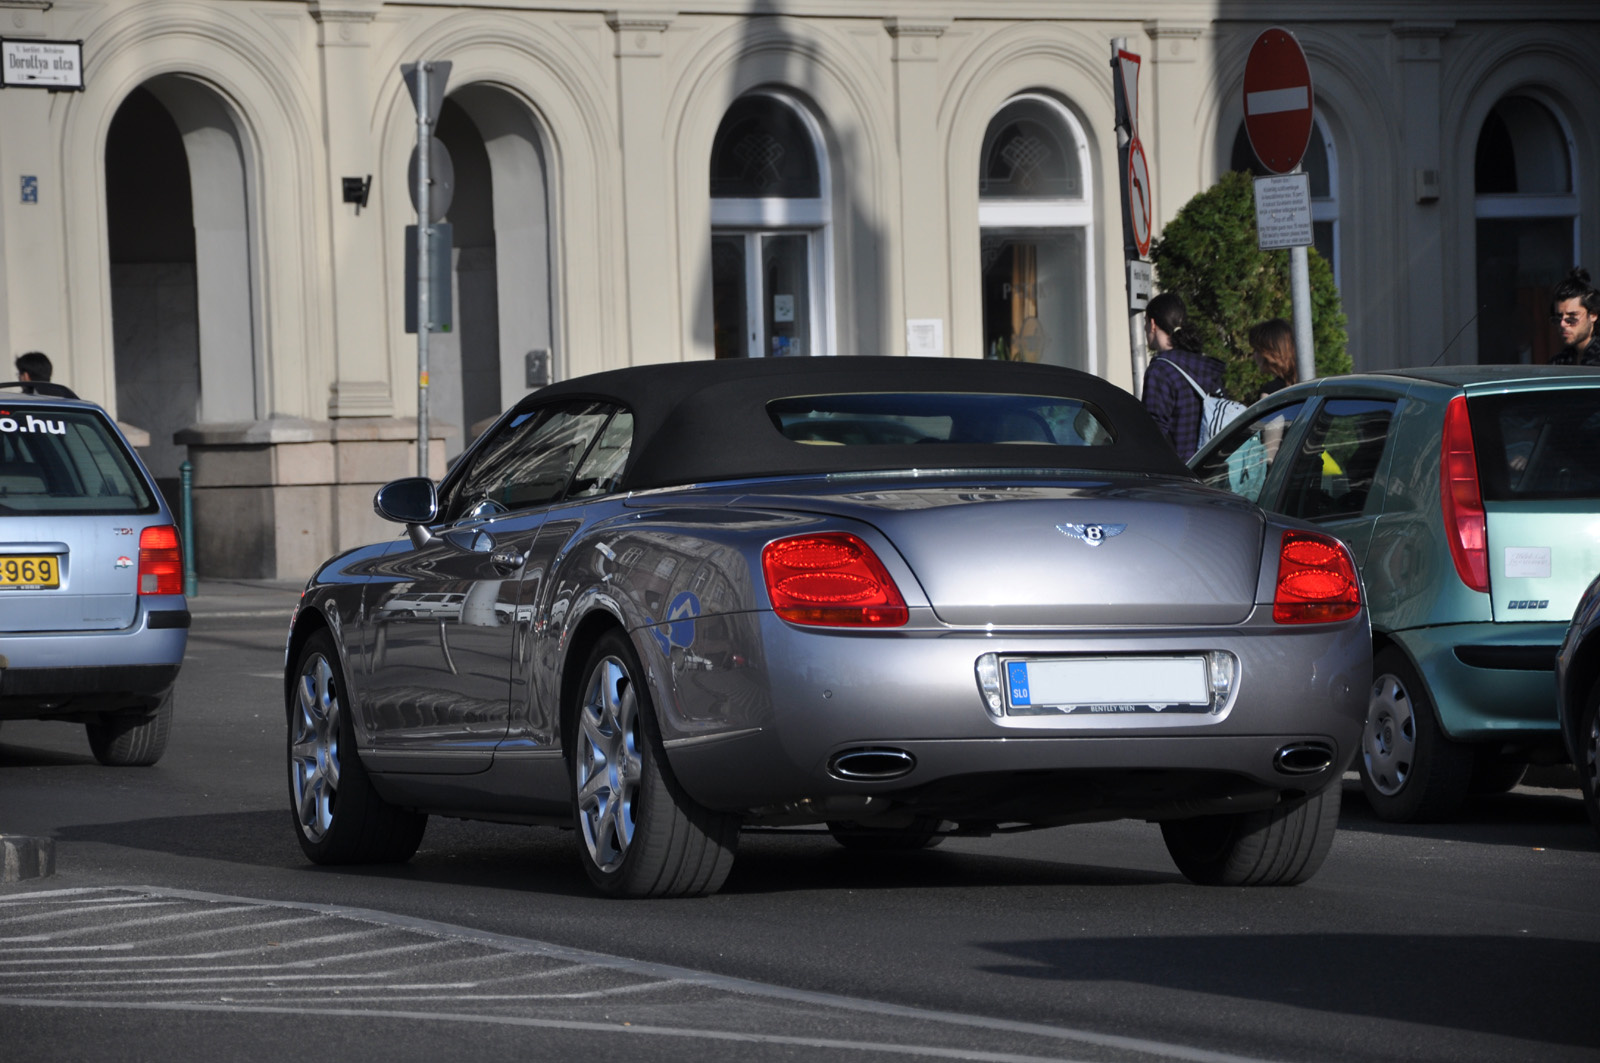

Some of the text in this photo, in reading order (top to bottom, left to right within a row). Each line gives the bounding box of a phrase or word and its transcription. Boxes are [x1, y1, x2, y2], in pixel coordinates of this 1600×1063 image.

[9, 53, 74, 74] Dorottya utca
[1087, 526, 1102, 540] B
[1013, 688, 1028, 698] SLO
